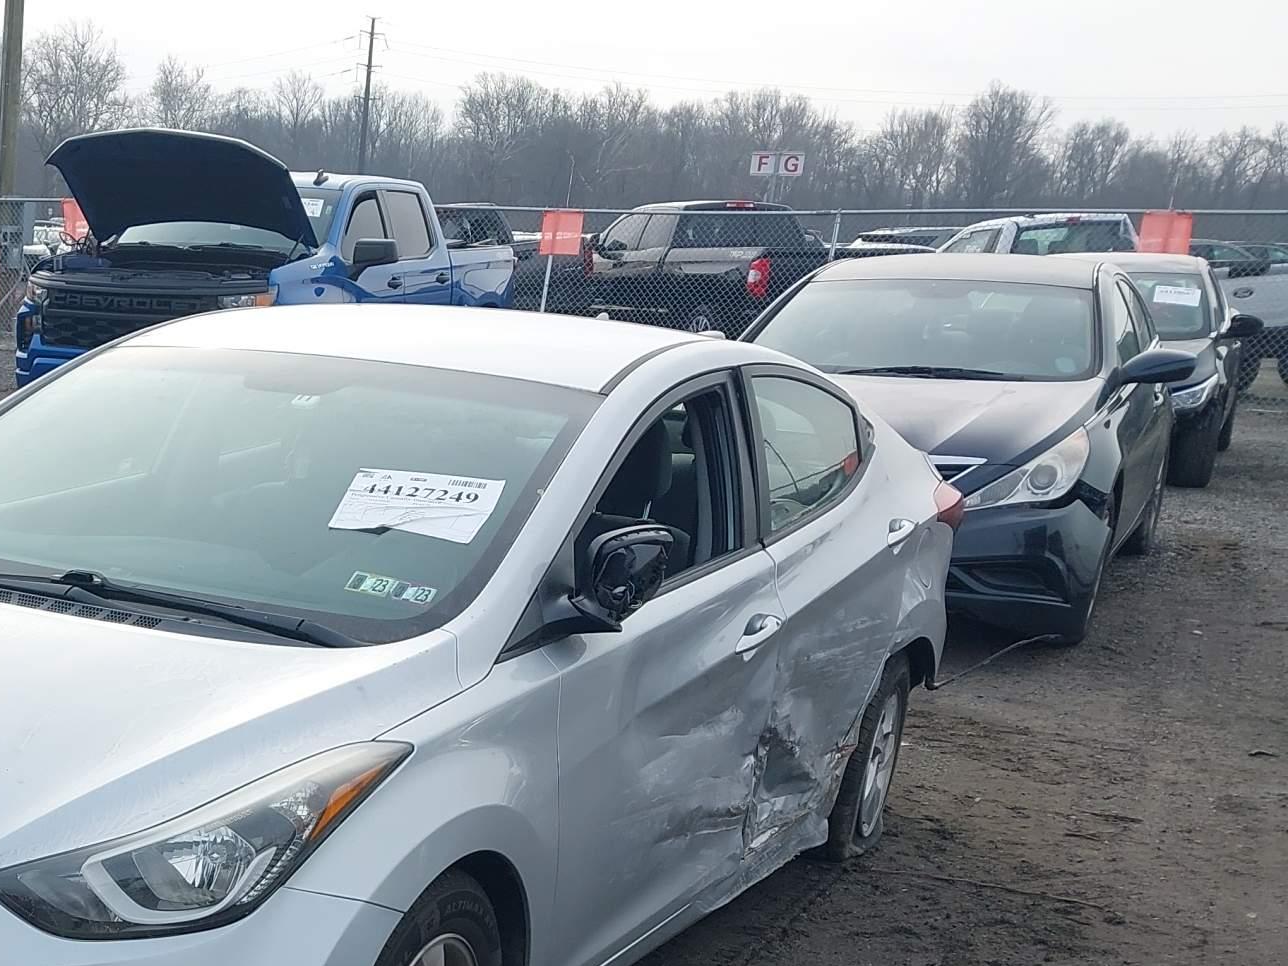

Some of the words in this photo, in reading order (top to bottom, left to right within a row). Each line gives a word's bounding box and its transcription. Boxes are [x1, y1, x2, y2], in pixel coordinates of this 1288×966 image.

[757, 155, 770, 172] F
[784, 155, 799, 172] G
[53, 292, 202, 313] CHEVROLET
[363, 483, 479, 504] 44127249
[372, 578, 389, 593] 23
[414, 587, 432, 602] 23
